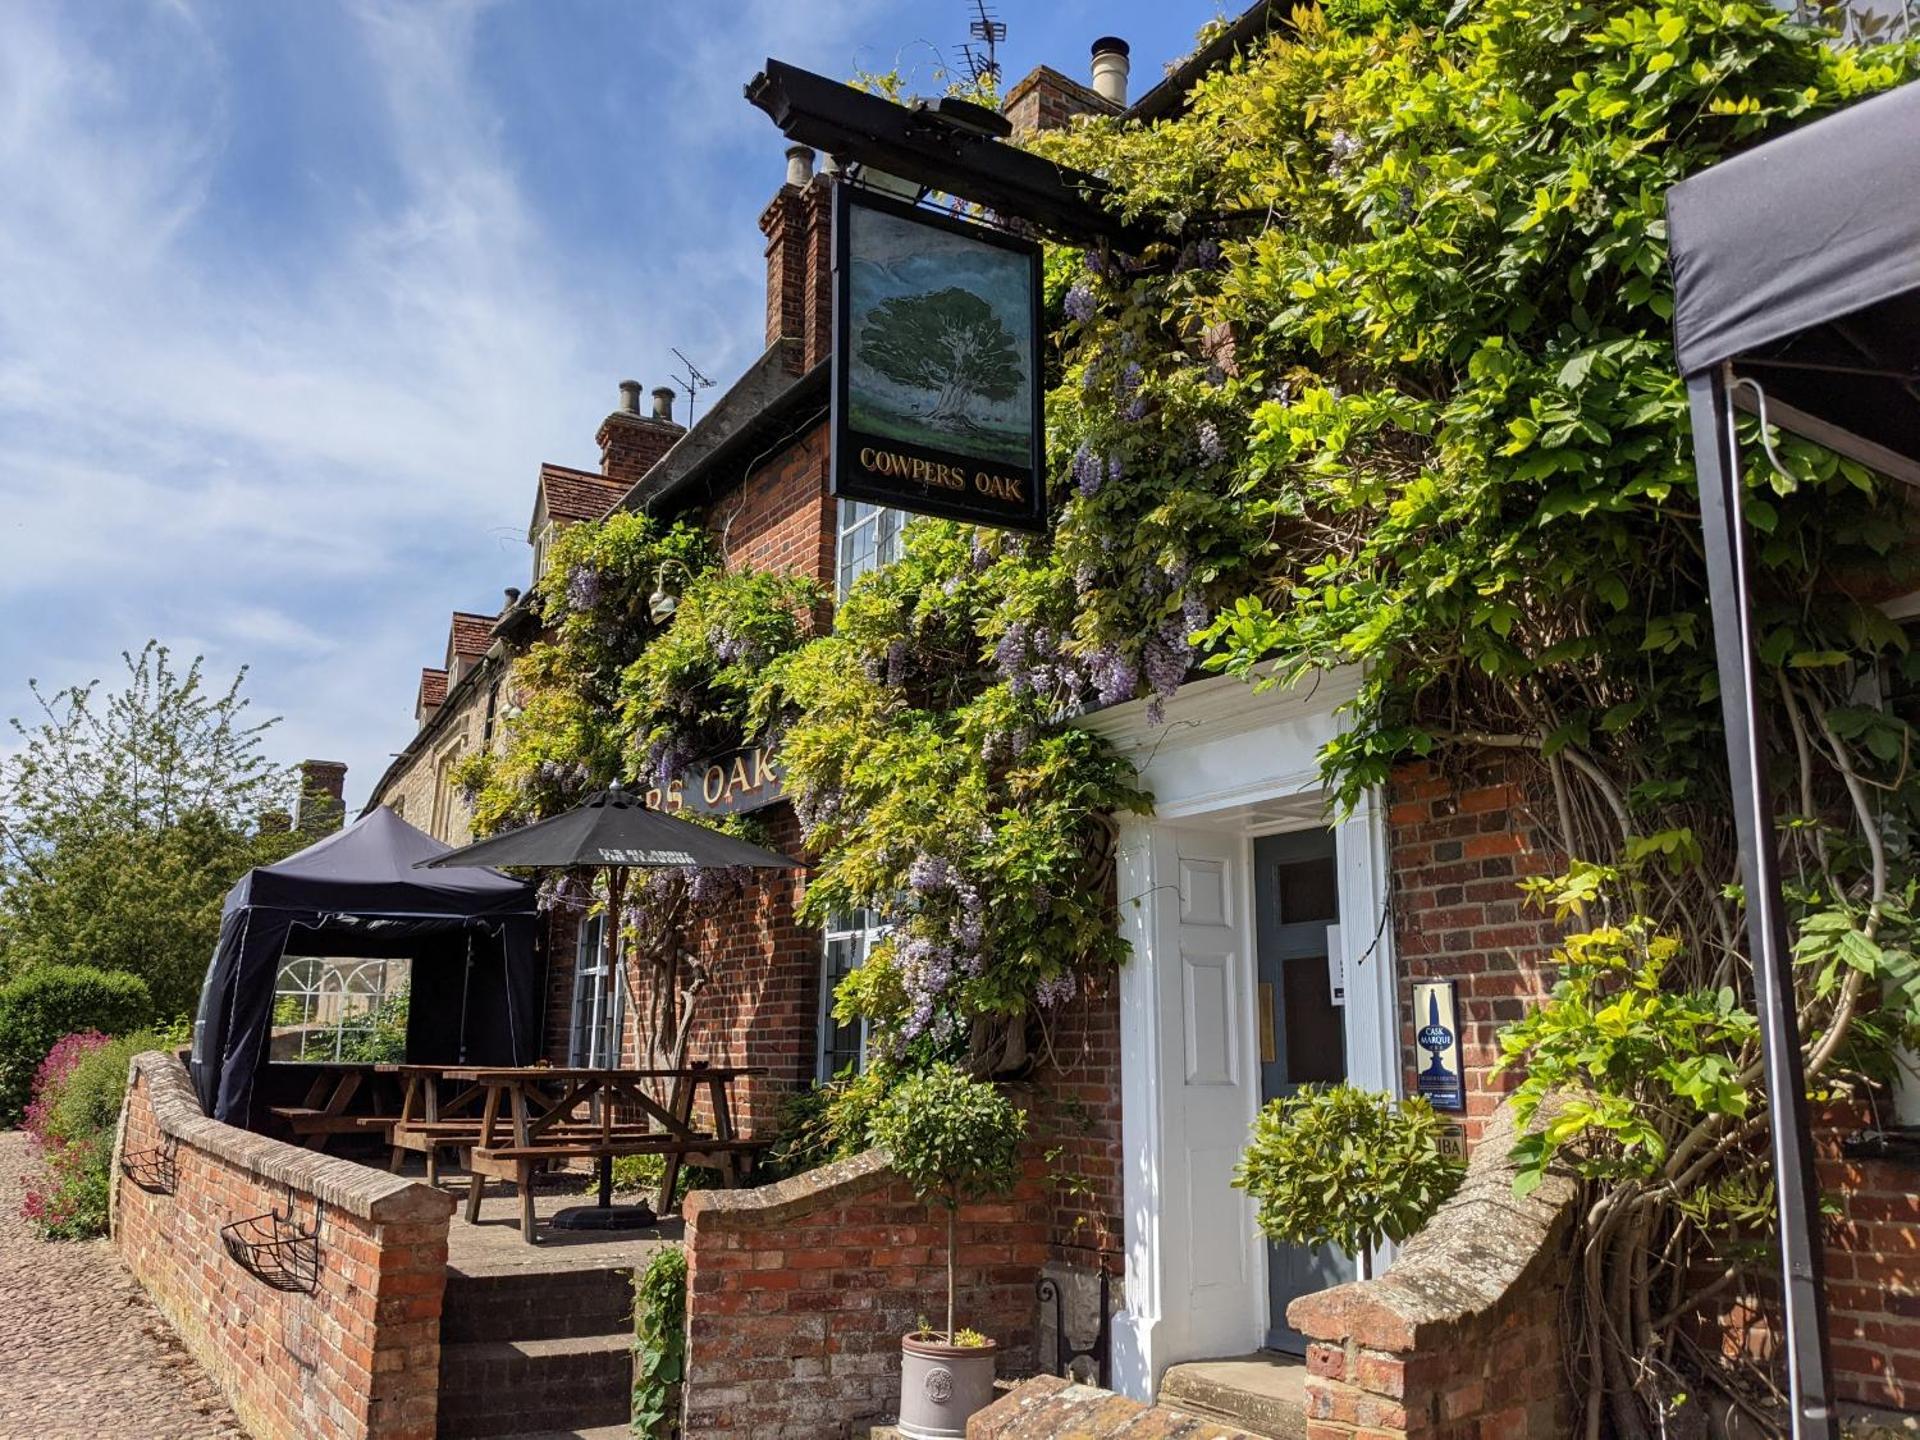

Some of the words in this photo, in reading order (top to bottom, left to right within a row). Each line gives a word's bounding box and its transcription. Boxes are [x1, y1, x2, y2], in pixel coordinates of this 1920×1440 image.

[860, 447, 965, 488] COWPERS
[974, 471, 1024, 501] OAK
[645, 779, 683, 815] RS
[703, 745, 777, 804] OAK
[1421, 1035, 1450, 1045] MARQUE
[1425, 1027, 1445, 1036] CASK
